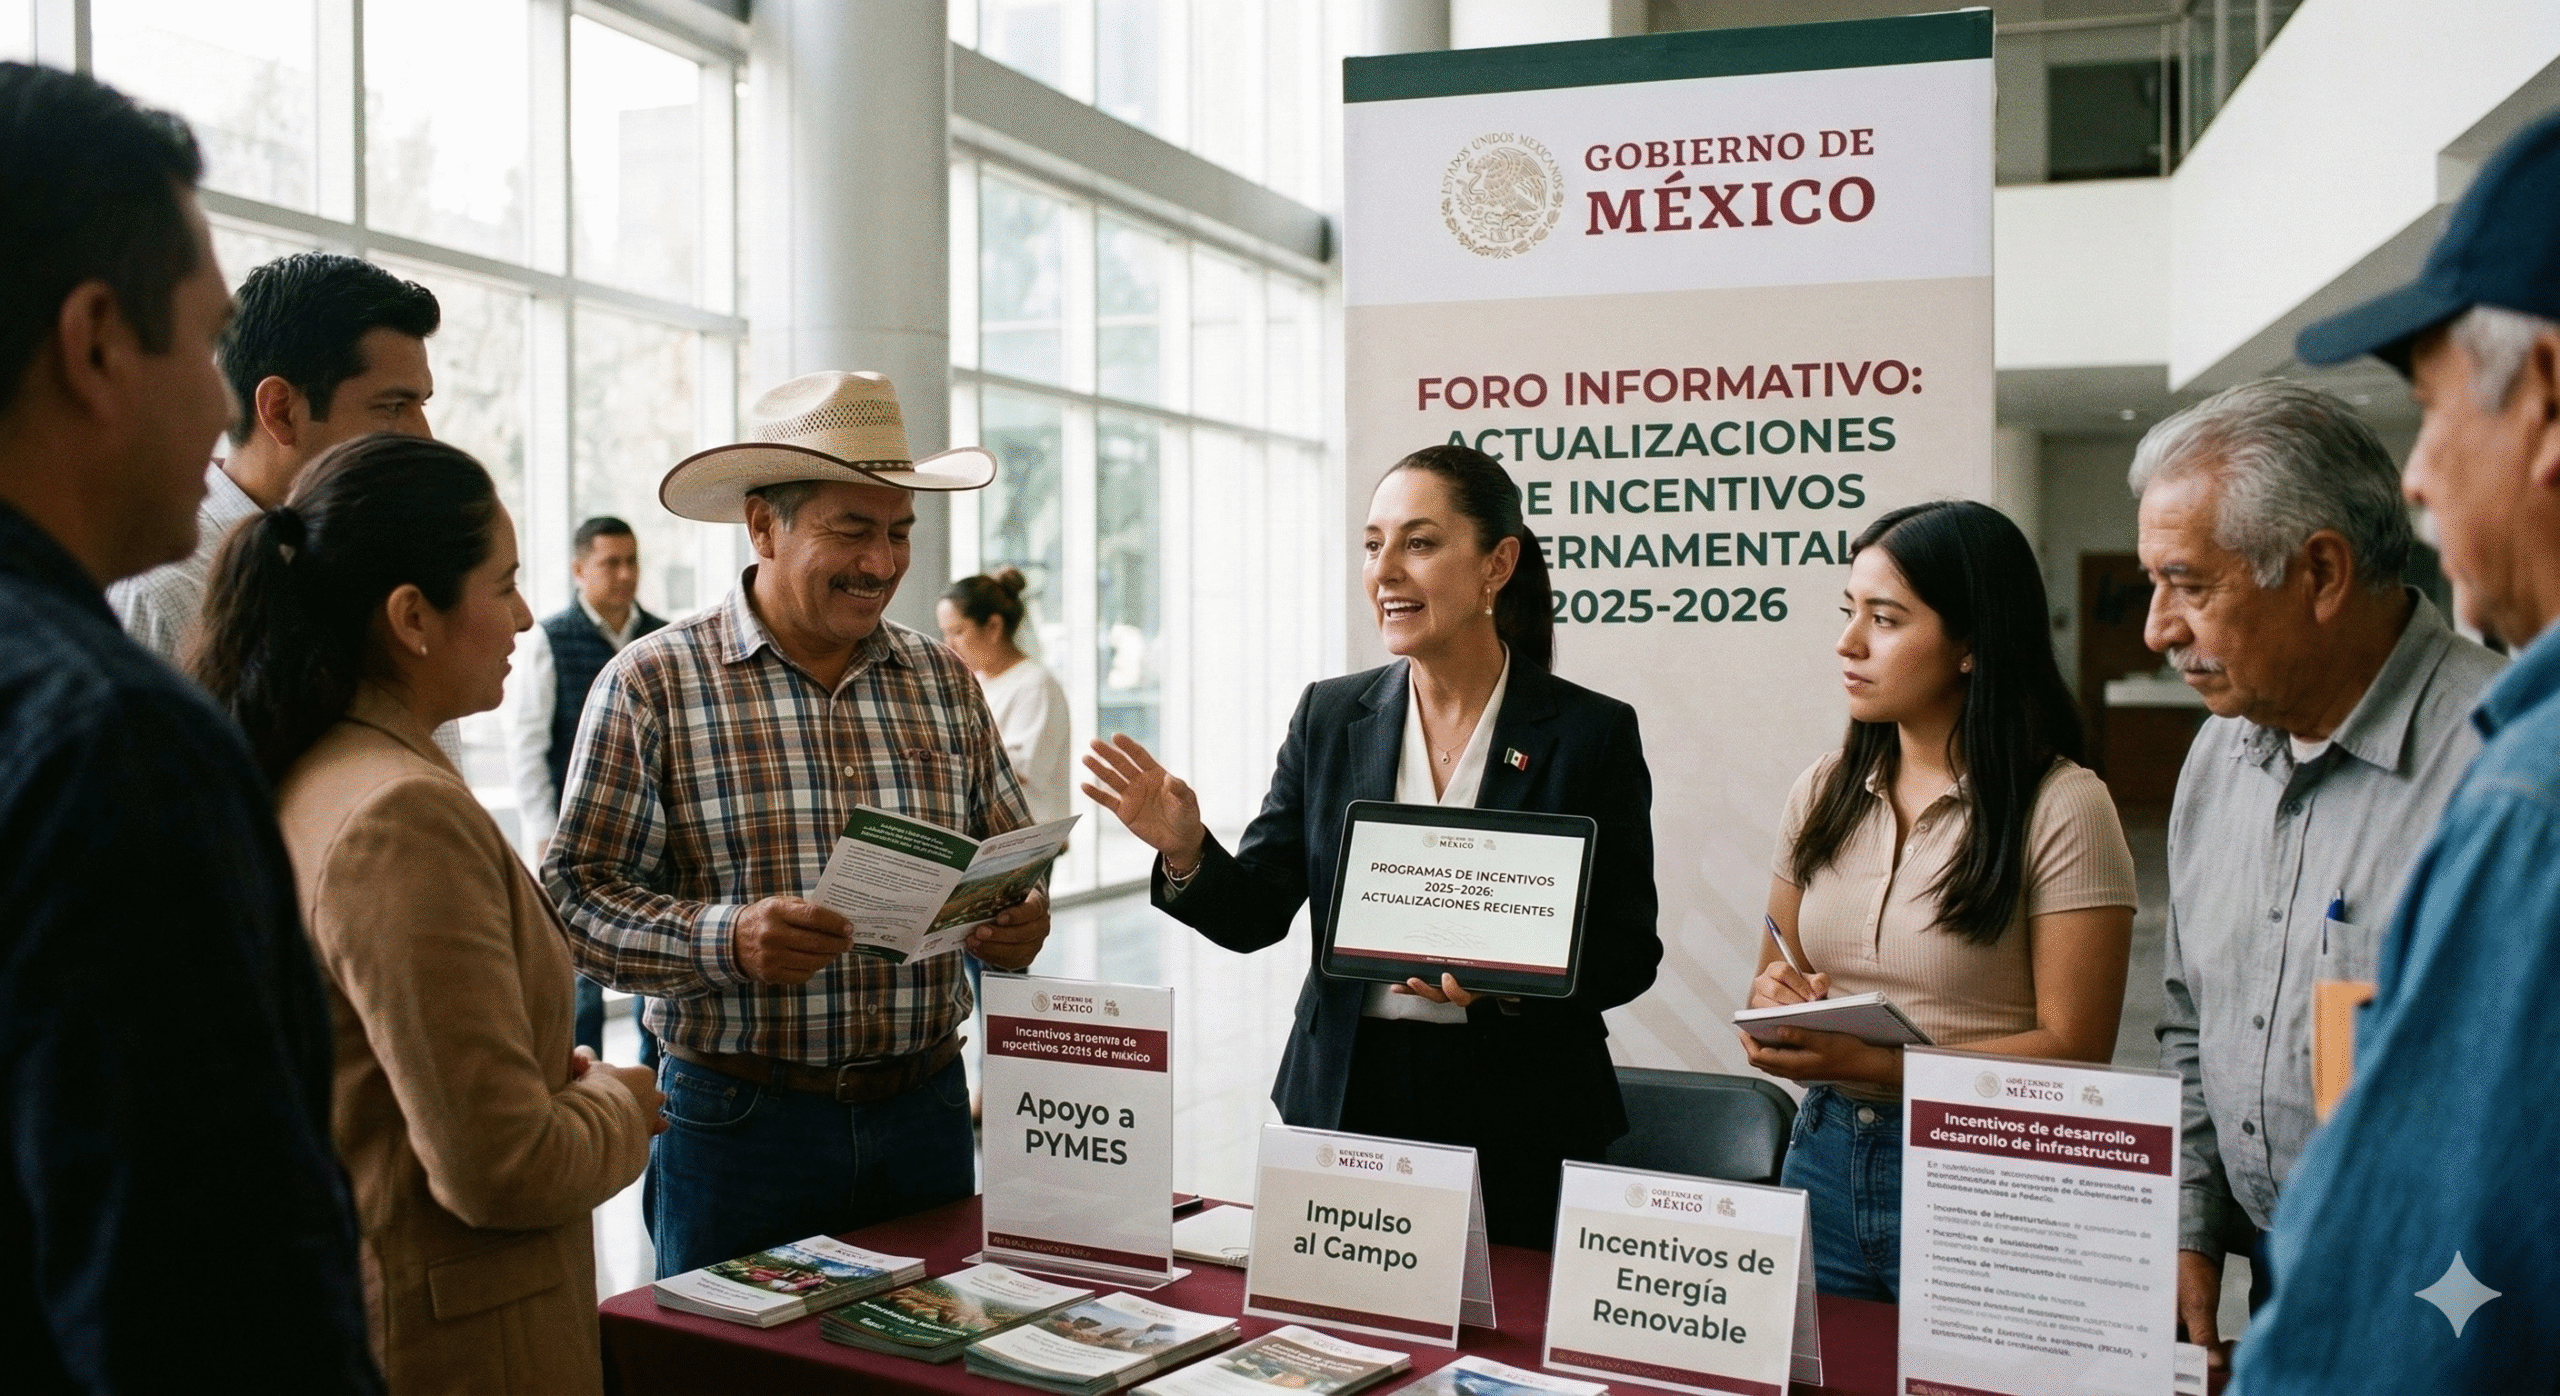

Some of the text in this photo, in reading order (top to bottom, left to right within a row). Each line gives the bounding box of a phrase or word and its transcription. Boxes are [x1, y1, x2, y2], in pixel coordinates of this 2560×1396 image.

[1585, 128, 1875, 171] GOBIERNO DE
[1584, 172, 1876, 236] MÉXICO
[1417, 360, 1923, 411] FORO INFORMATIVO:
[1570, 473, 1867, 515] INCENTIVOS
[1552, 586, 1789, 624] 2025-2026
[1370, 861, 1555, 887] PROGRAMAS DE INCENTIVOS
[1361, 891, 1555, 917] ACTUALIZACIONES RECIENTES
[1052, 1000, 1093, 1014] MÉXICO
[1094, 1047, 1108, 1059] de
[1123, 1035, 1137, 1048] de
[1016, 1091, 1135, 1130] Apoyo a
[2005, 1085, 2064, 1101] MÉXICO
[1026, 1128, 1128, 1166] PYMES
[1929, 1127, 2150, 1165] desarrollo de infrastructura
[1944, 1112, 2136, 1146] Incentivos de desarrollo
[1338, 1156, 1384, 1171] MÉXICO
[1306, 1199, 1412, 1235] Impulso
[1293, 1232, 1418, 1272] al Campo
[1578, 1226, 1775, 1276] Incentivos de
[1616, 1267, 1727, 1307] Energía
[1592, 1298, 1747, 1345] Renovable
